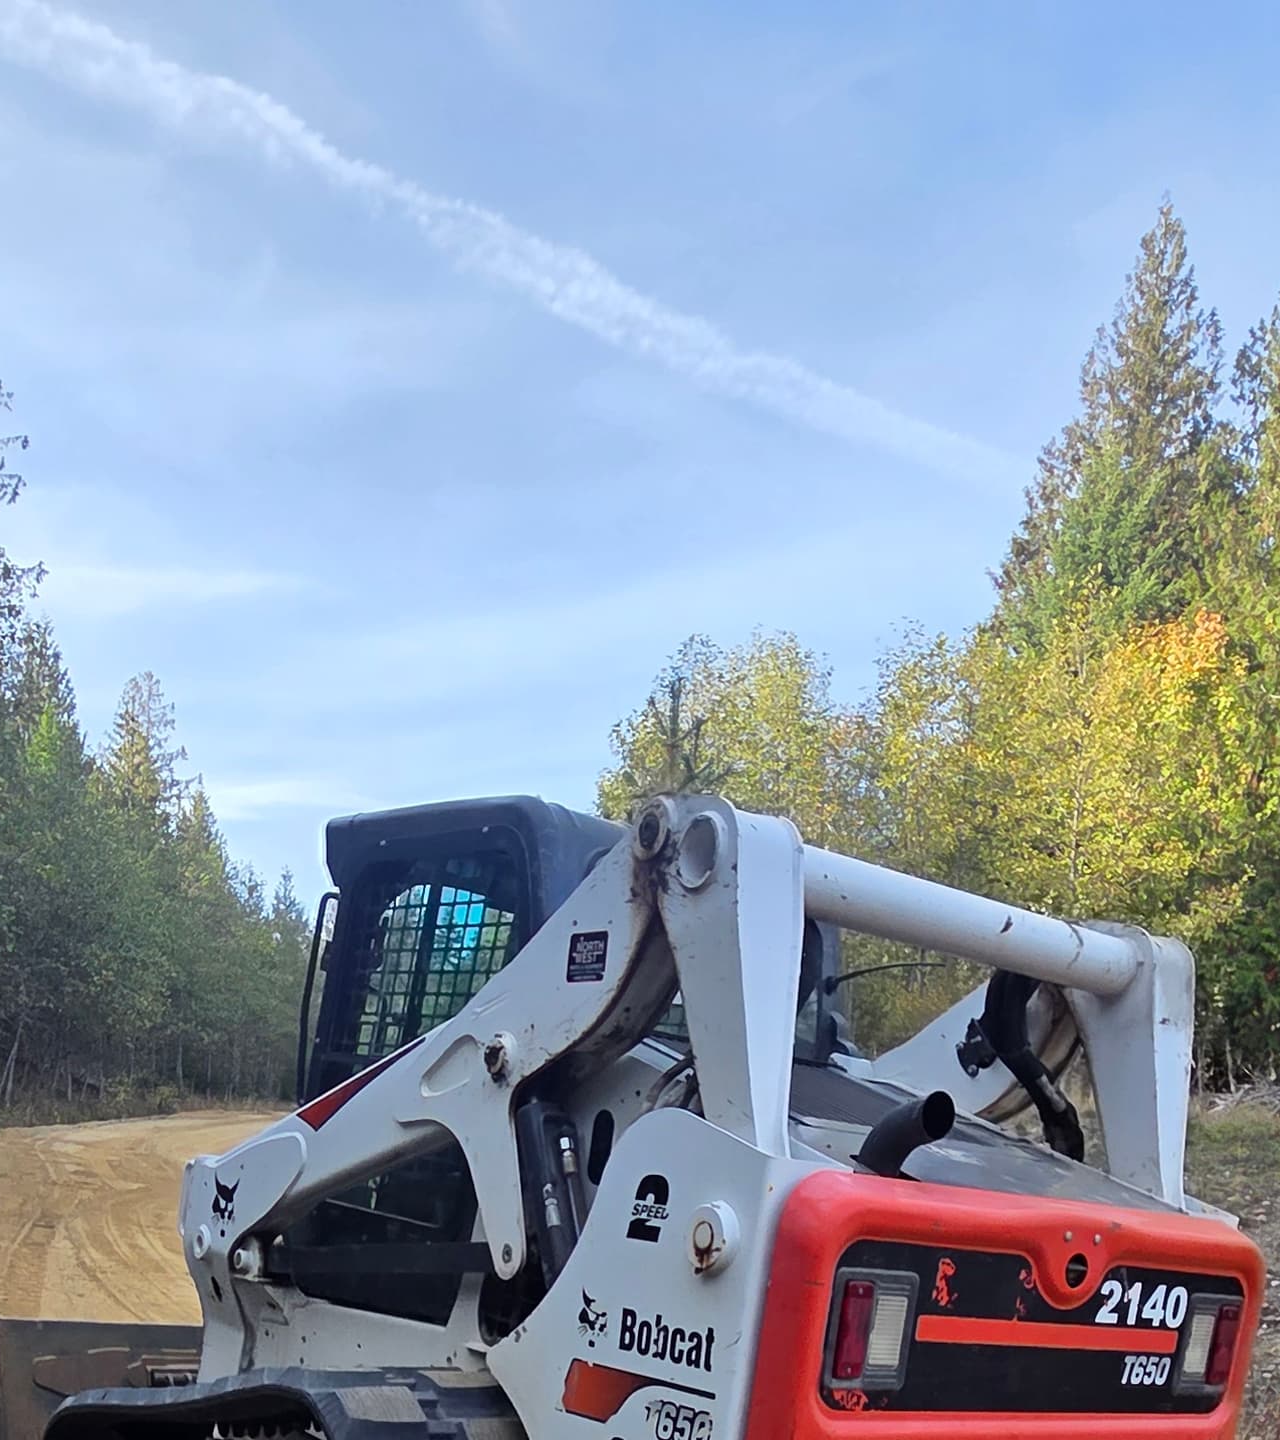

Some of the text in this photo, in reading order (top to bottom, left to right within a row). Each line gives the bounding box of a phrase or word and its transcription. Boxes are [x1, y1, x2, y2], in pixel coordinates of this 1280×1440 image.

[626, 1174, 669, 1243] 2
[1095, 1280, 1188, 1328] 2140
[619, 1308, 715, 1372] Bobcat
[1121, 1355, 1172, 1386] T650
